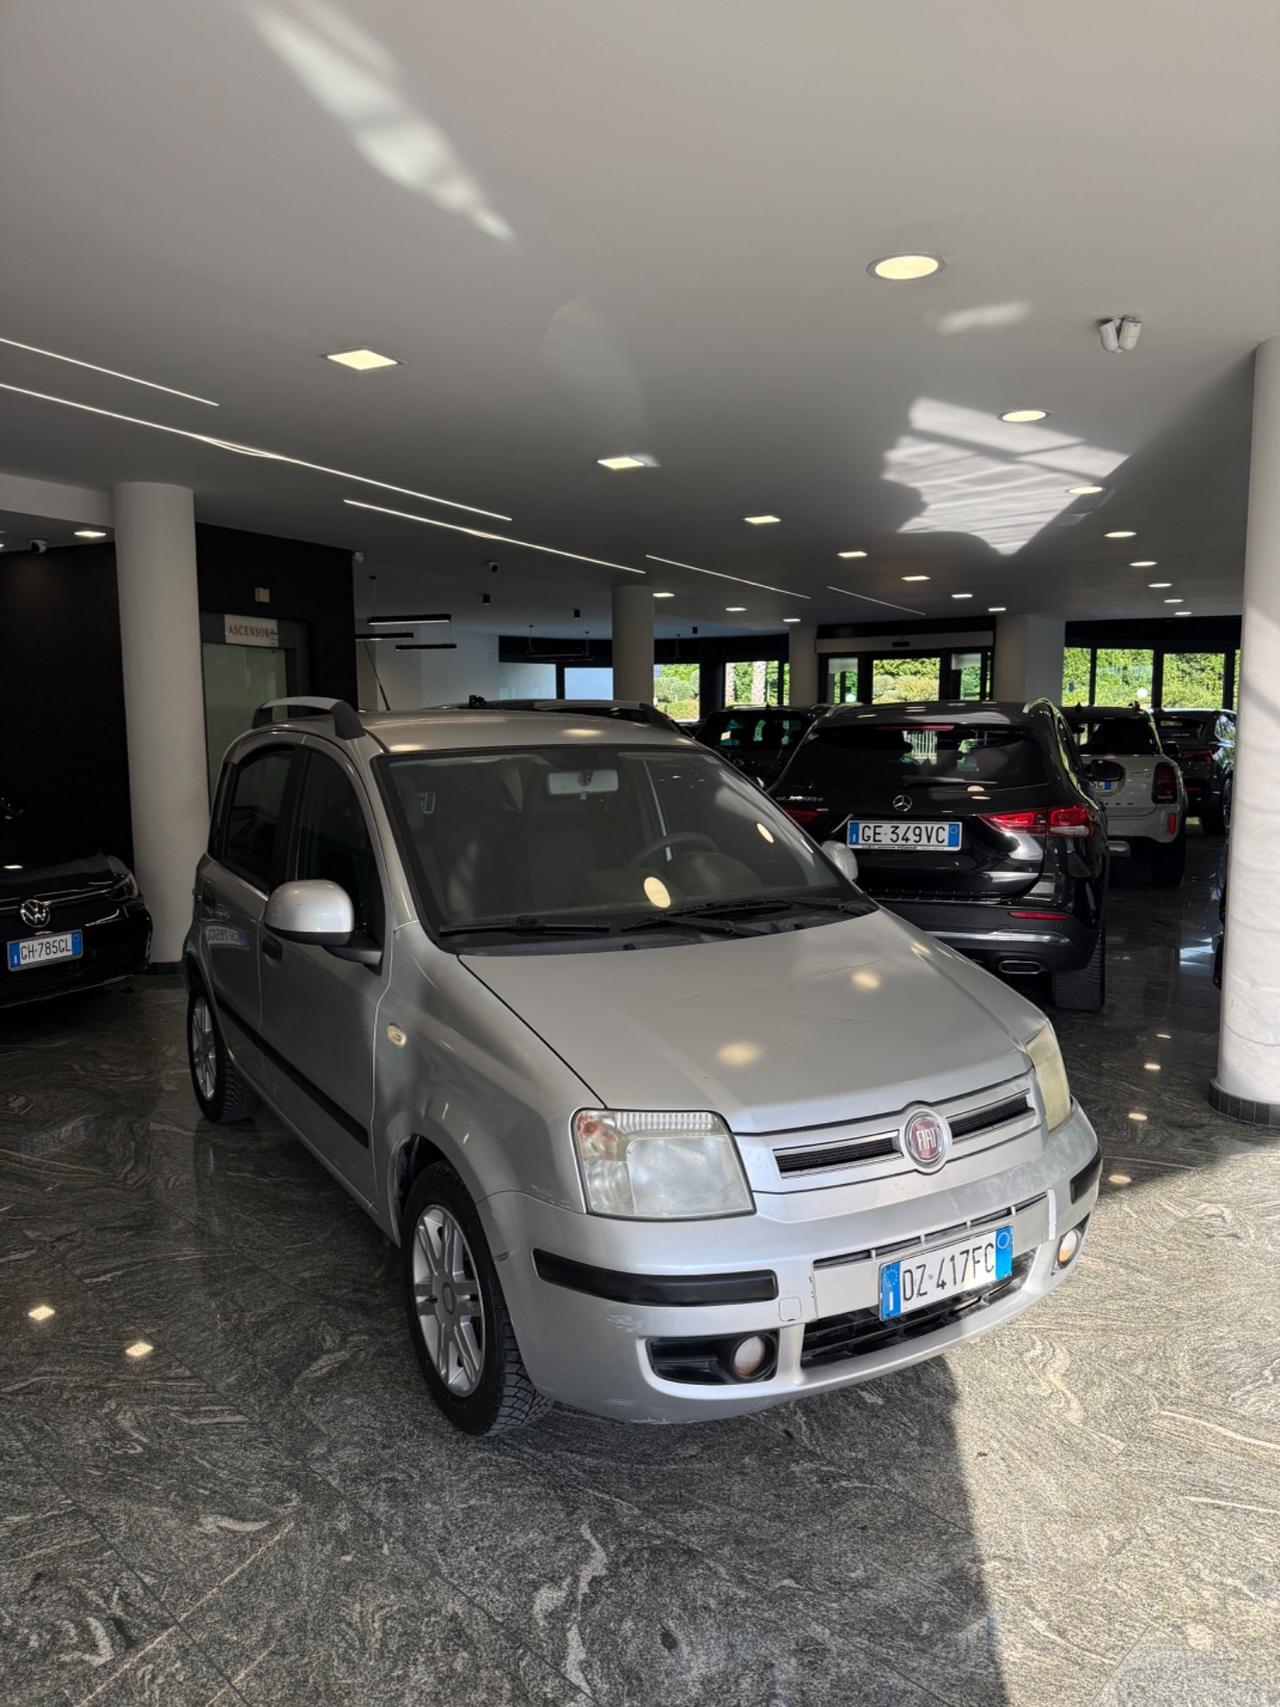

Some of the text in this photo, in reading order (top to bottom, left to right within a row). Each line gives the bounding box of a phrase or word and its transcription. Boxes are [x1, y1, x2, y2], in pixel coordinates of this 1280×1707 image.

[861, 825, 883, 843] GE
[889, 825, 946, 844] 349VC
[915, 1127, 938, 1152] FIAT
[902, 1263, 929, 1302] DZ
[935, 1242, 995, 1291] 417FC
